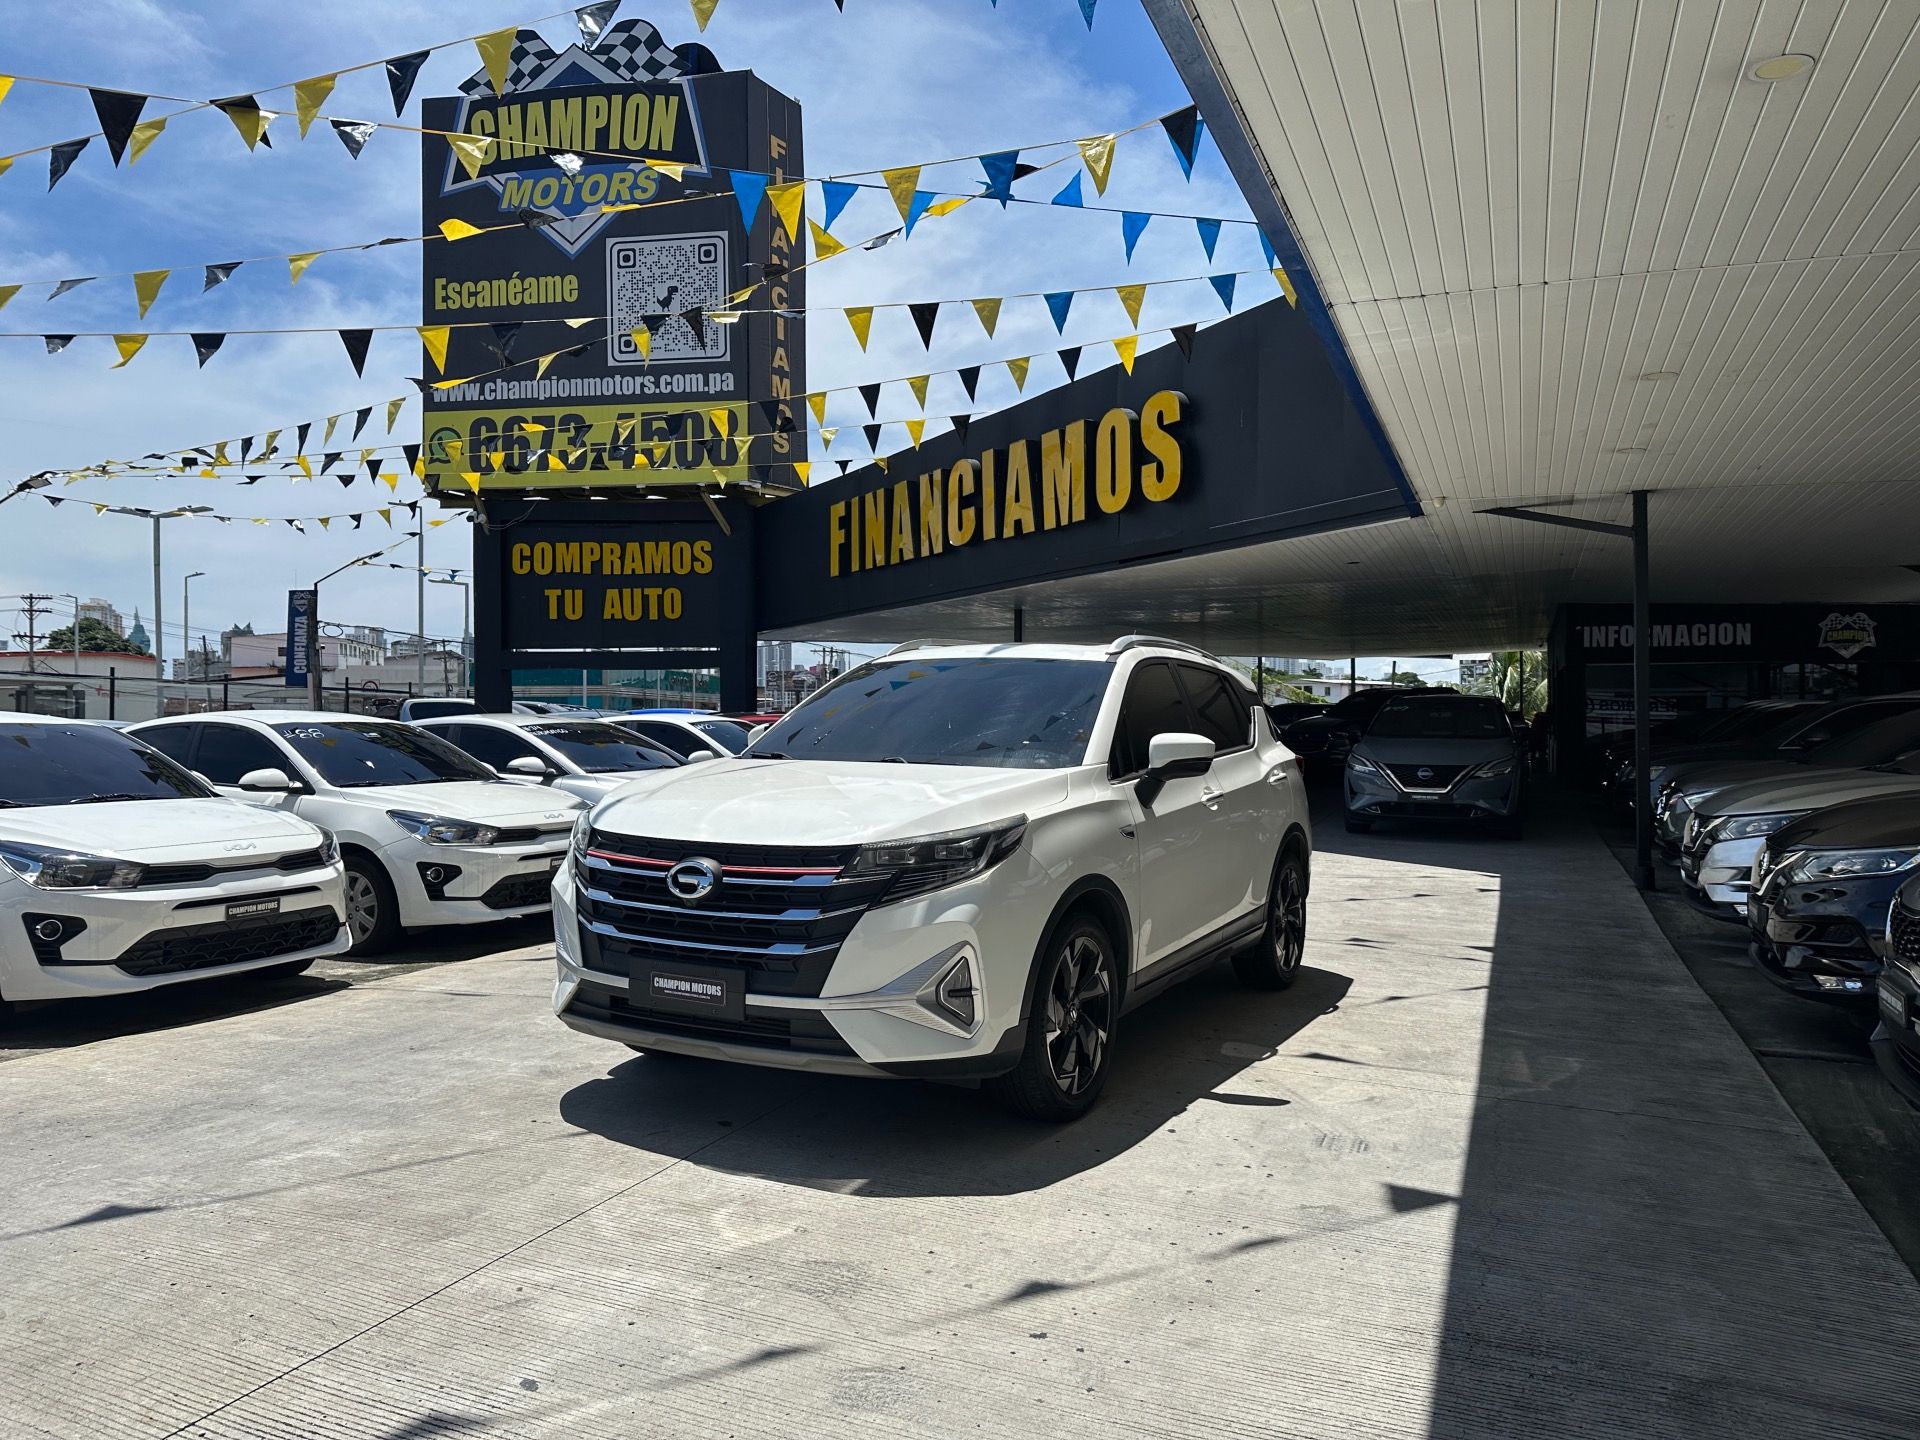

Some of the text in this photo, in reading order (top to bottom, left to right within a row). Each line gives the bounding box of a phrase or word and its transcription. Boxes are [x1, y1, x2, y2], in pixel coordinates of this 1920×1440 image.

[470, 94, 679, 166] CHAMPION
[501, 170, 658, 209] MOTORS
[434, 271, 579, 310] Escanéame
[770, 134, 792, 454] FIACIAMOS
[432, 372, 735, 403] www.championmotors.com.pa
[469, 409, 739, 476] 6673-4508
[829, 390, 1183, 578] FINANCIAMOS
[511, 540, 713, 575] COMPRAMOS
[544, 587, 682, 621] TU AUTO
[293, 615, 308, 674] CONFIANZA
[1583, 622, 1752, 648] INFOMACION
[228, 904, 257, 915] CHAMPION
[257, 901, 278, 911] MOTORS
[654, 977, 690, 992] CHAMPION
[691, 983, 722, 997] MOTORS
